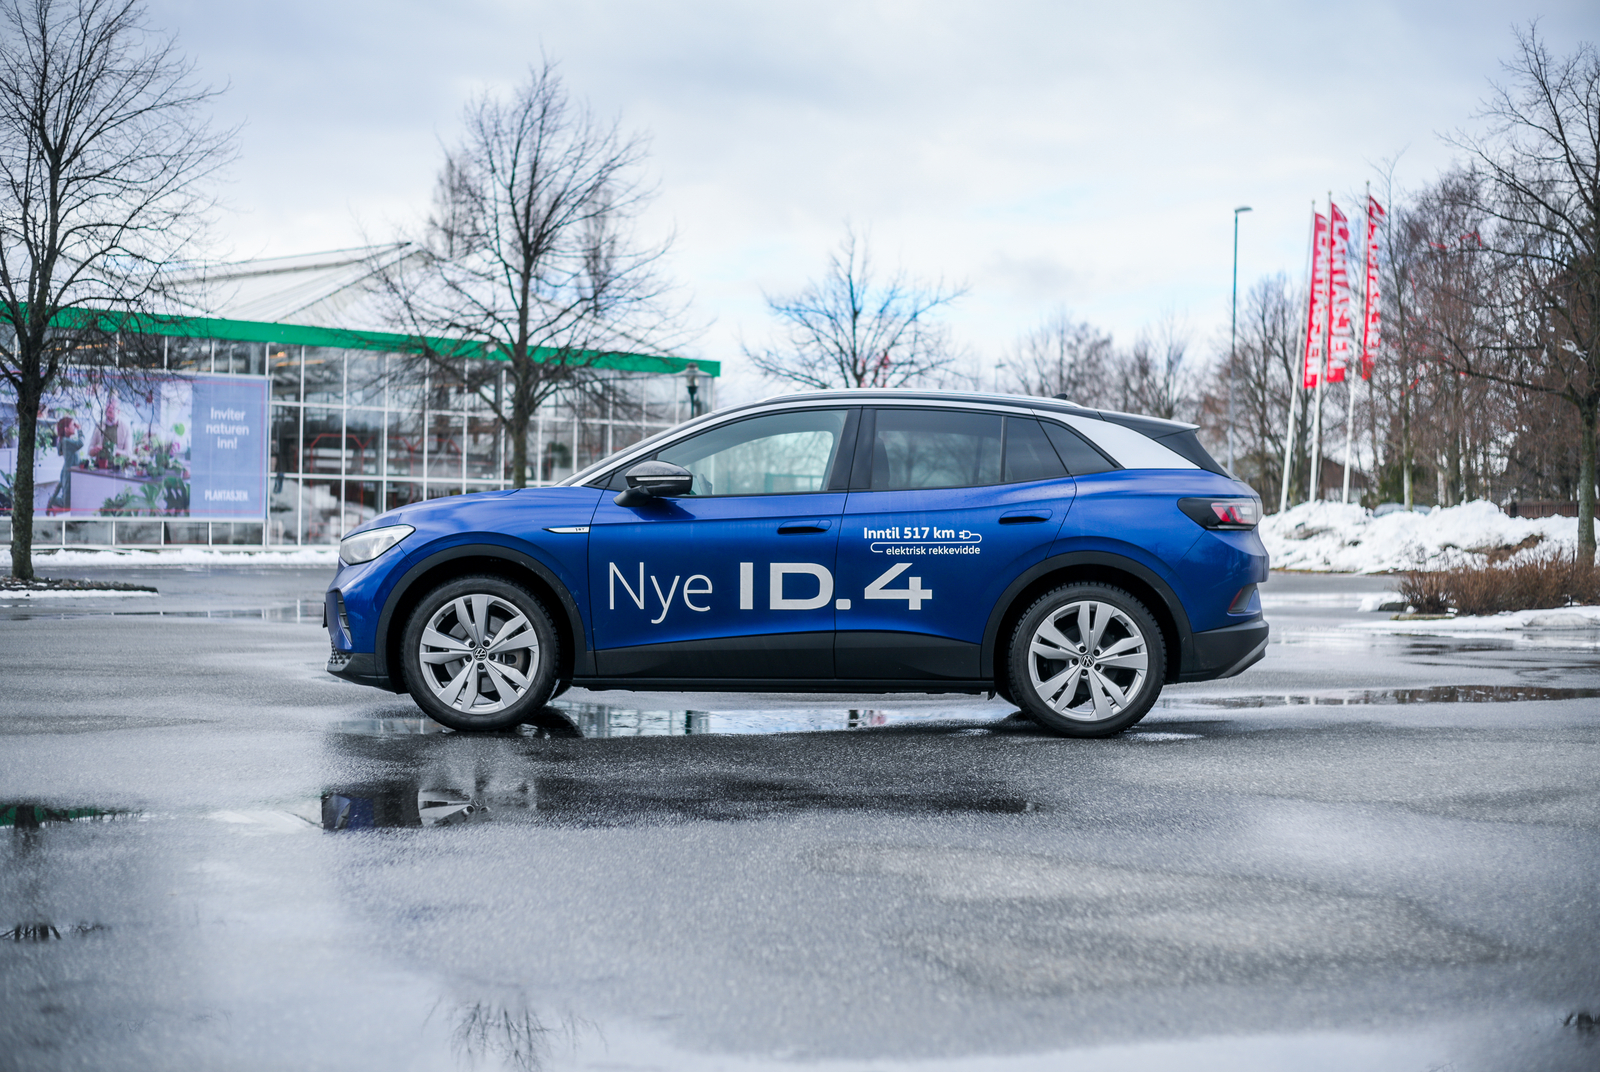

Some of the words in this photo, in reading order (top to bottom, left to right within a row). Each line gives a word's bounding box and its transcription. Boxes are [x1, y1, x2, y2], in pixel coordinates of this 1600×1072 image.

[210, 406, 246, 421] Inviter
[206, 423, 249, 436] naturen
[217, 436, 238, 449] inn!
[864, 527, 900, 538] Inntil
[904, 527, 929, 538] 517
[934, 527, 954, 538] km
[886, 546, 926, 555] elektrisk
[929, 546, 980, 554] rekkevidde
[610, 562, 712, 623] Nye
[740, 563, 932, 610] ID.4
